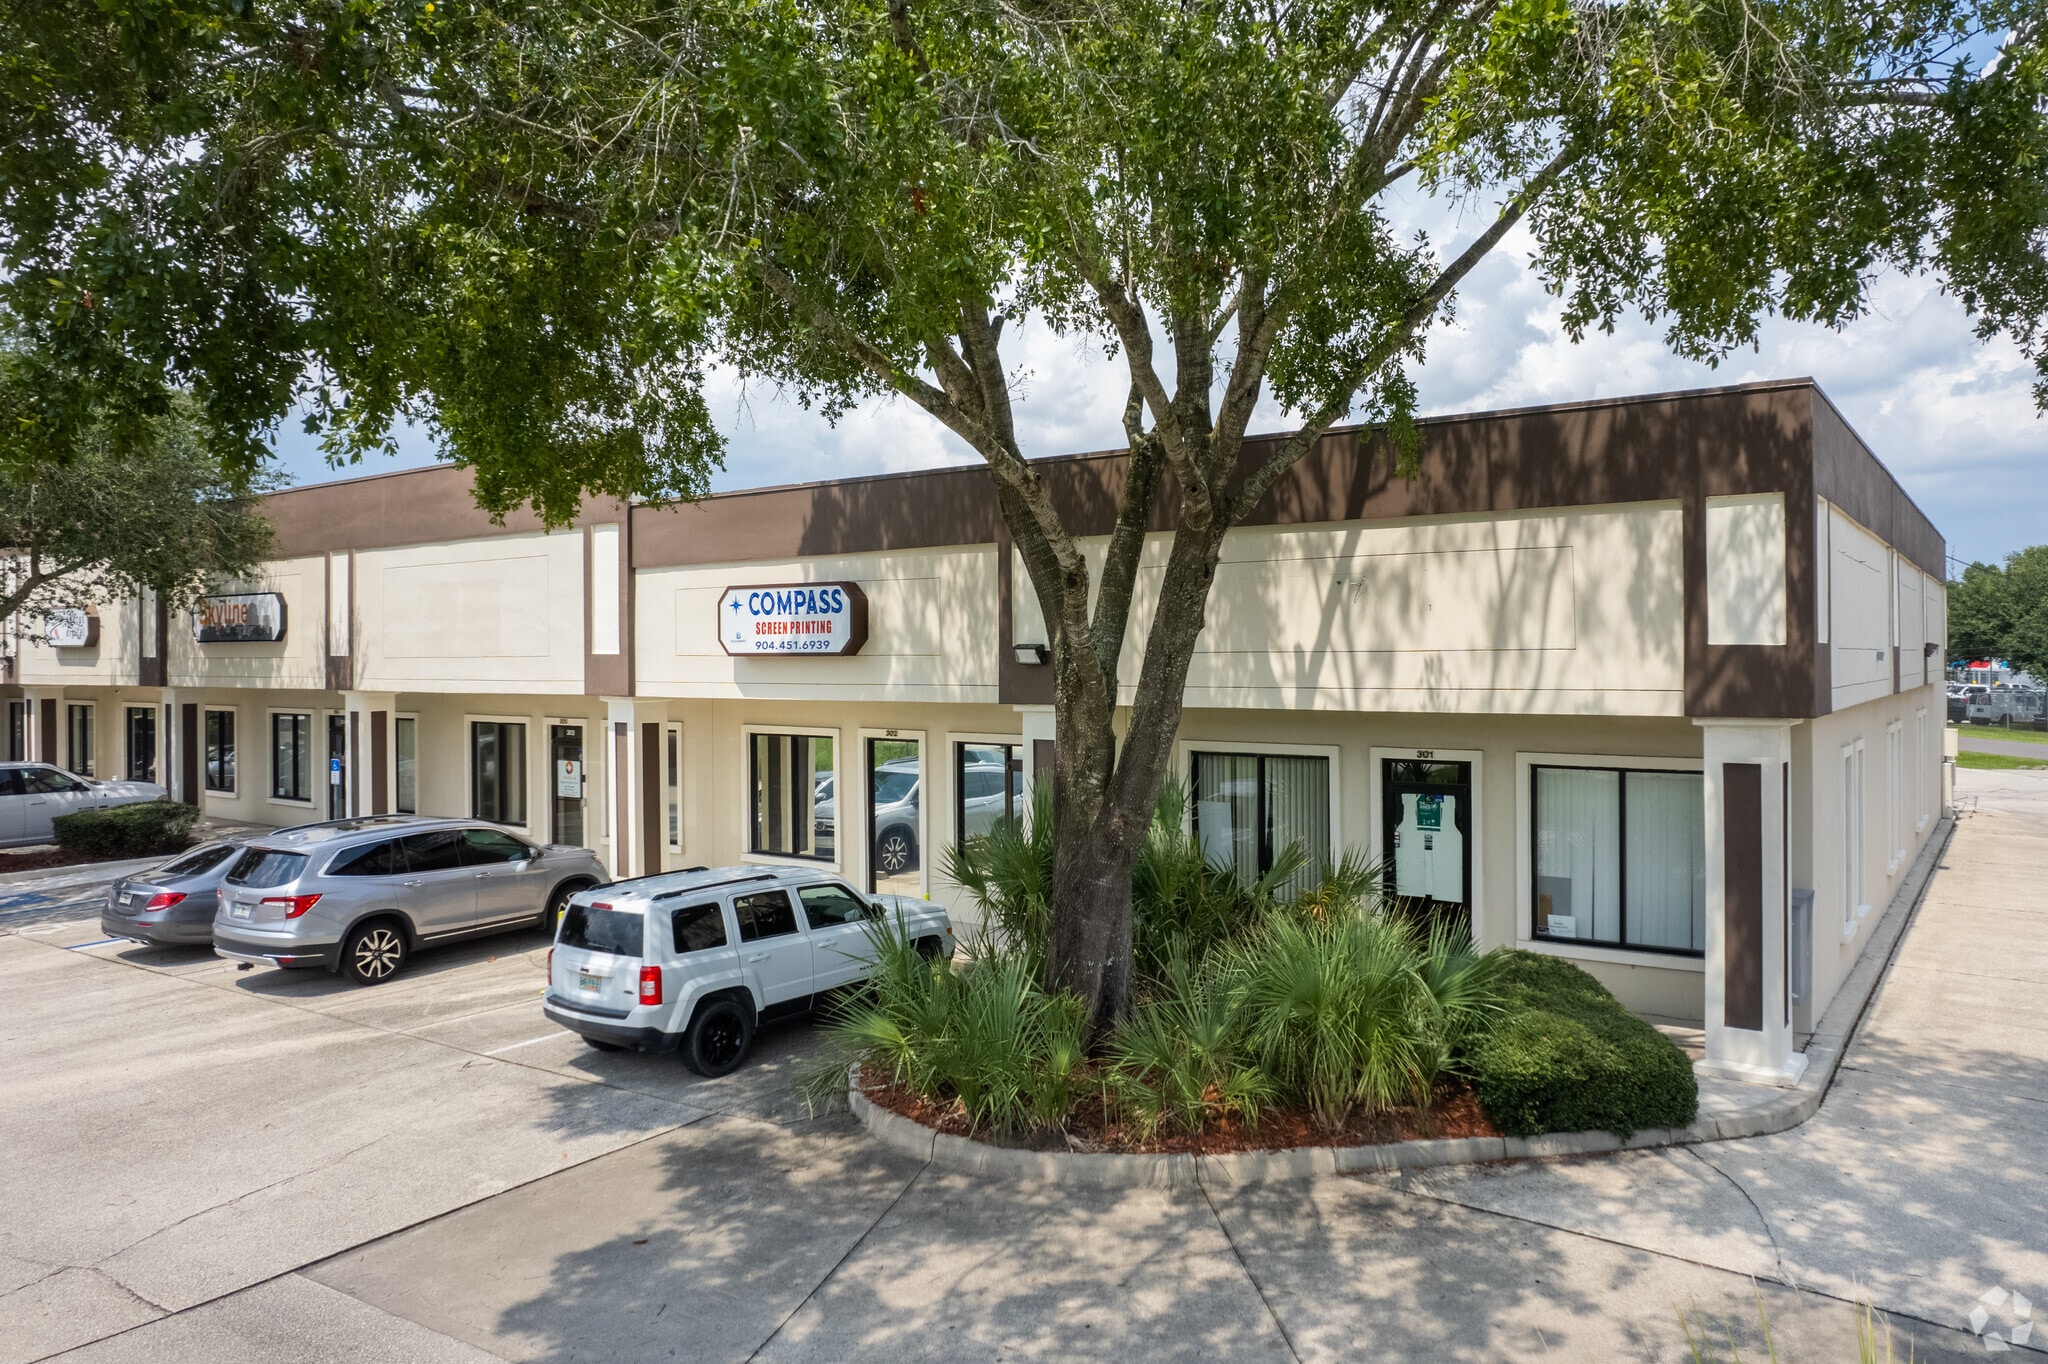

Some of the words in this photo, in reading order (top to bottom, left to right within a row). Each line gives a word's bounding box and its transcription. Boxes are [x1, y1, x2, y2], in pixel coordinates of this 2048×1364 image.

[748, 588, 843, 616] COMPASS
[199, 599, 248, 634] Skyline
[755, 621, 788, 635] SCREEN
[790, 620, 832, 634] PRINTING
[755, 640, 830, 650] 904.451.6939
[1416, 750, 1434, 758] 301
